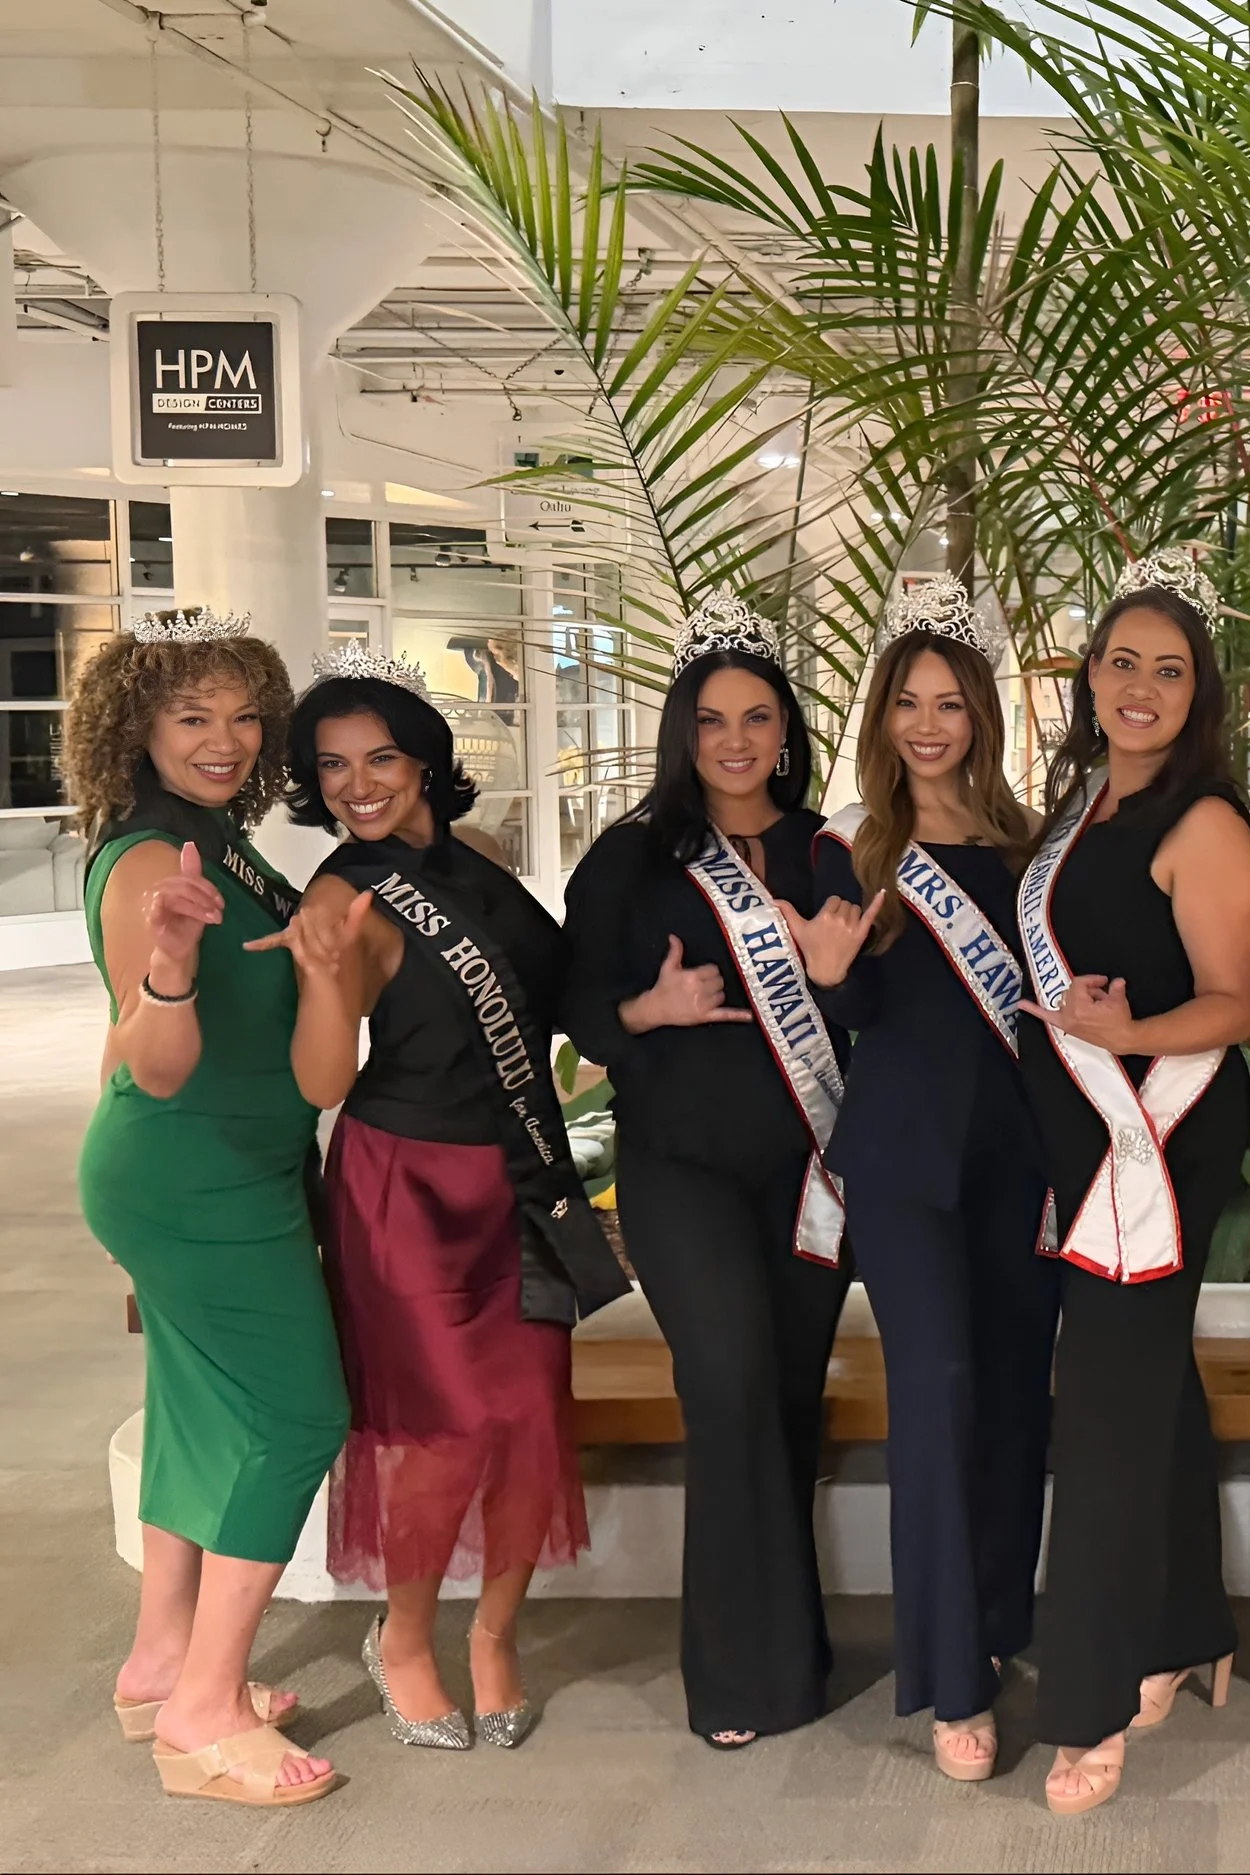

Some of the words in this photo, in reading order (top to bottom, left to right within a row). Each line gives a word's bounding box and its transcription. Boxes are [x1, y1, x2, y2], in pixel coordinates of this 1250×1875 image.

[155, 349, 257, 390] HPM
[156, 398, 200, 409] DESIGN
[208, 398, 258, 409] CENTERS
[222, 844, 265, 896] MISS
[898, 850, 965, 930] MRS.
[371, 872, 451, 937] MISS
[440, 936, 535, 1090] HONOLULU
[702, 849, 765, 914] MISS
[742, 922, 818, 1051] HAWAII
